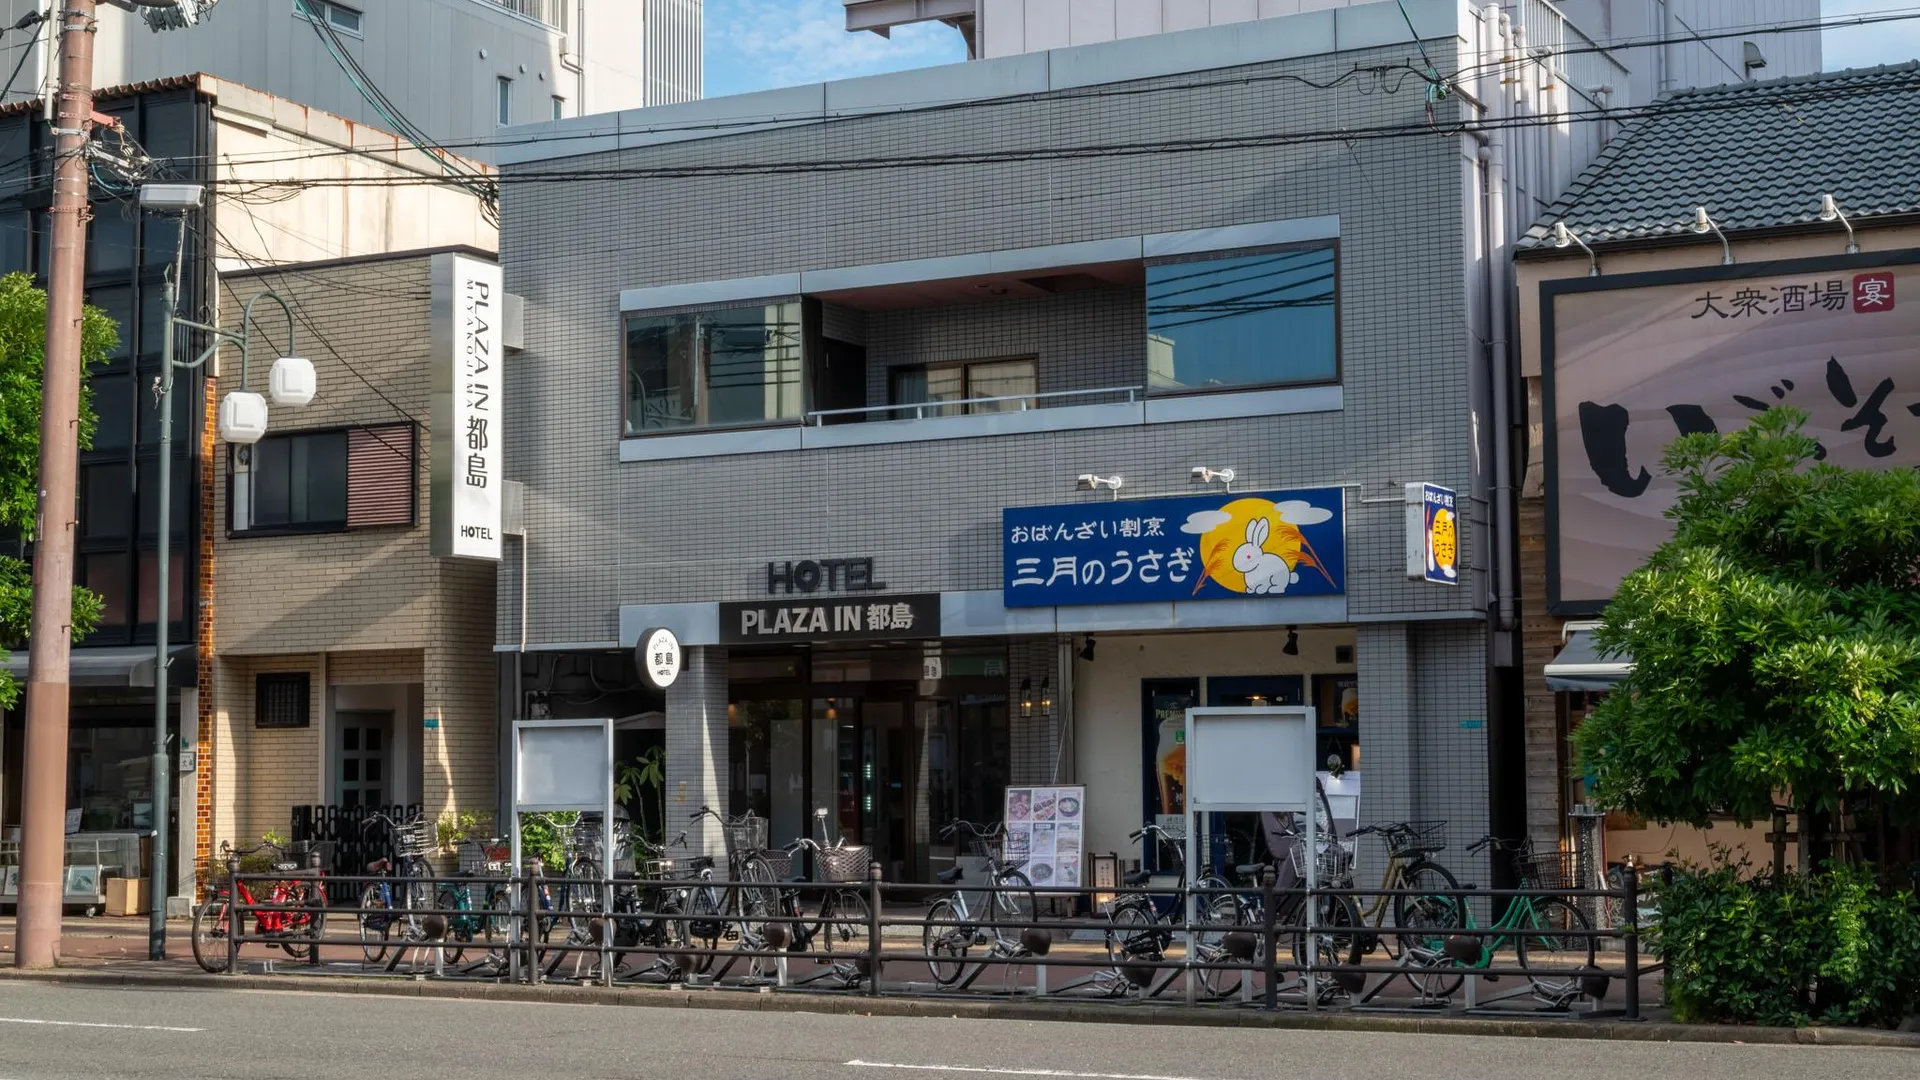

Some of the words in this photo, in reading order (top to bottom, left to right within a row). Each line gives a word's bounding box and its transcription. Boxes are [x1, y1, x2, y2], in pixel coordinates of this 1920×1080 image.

[1691, 280, 1849, 319] 大衆酒場
[1857, 278, 1890, 307] 宴
[466, 280, 474, 408] MIYAKOJIMA
[474, 281, 489, 375] PLAZA
[474, 383, 489, 411] IN
[466, 415, 489, 489] 都島
[461, 525, 493, 540] HOTEL
[1011, 517, 1166, 544] おばんざい割烹
[768, 557, 886, 594] HOTEL
[1012, 547, 1195, 588] 三月のうさぎ
[741, 607, 827, 635] PLAZA
[834, 606, 861, 632] IN
[867, 603, 914, 630] 都島
[654, 652, 674, 665] 都島
